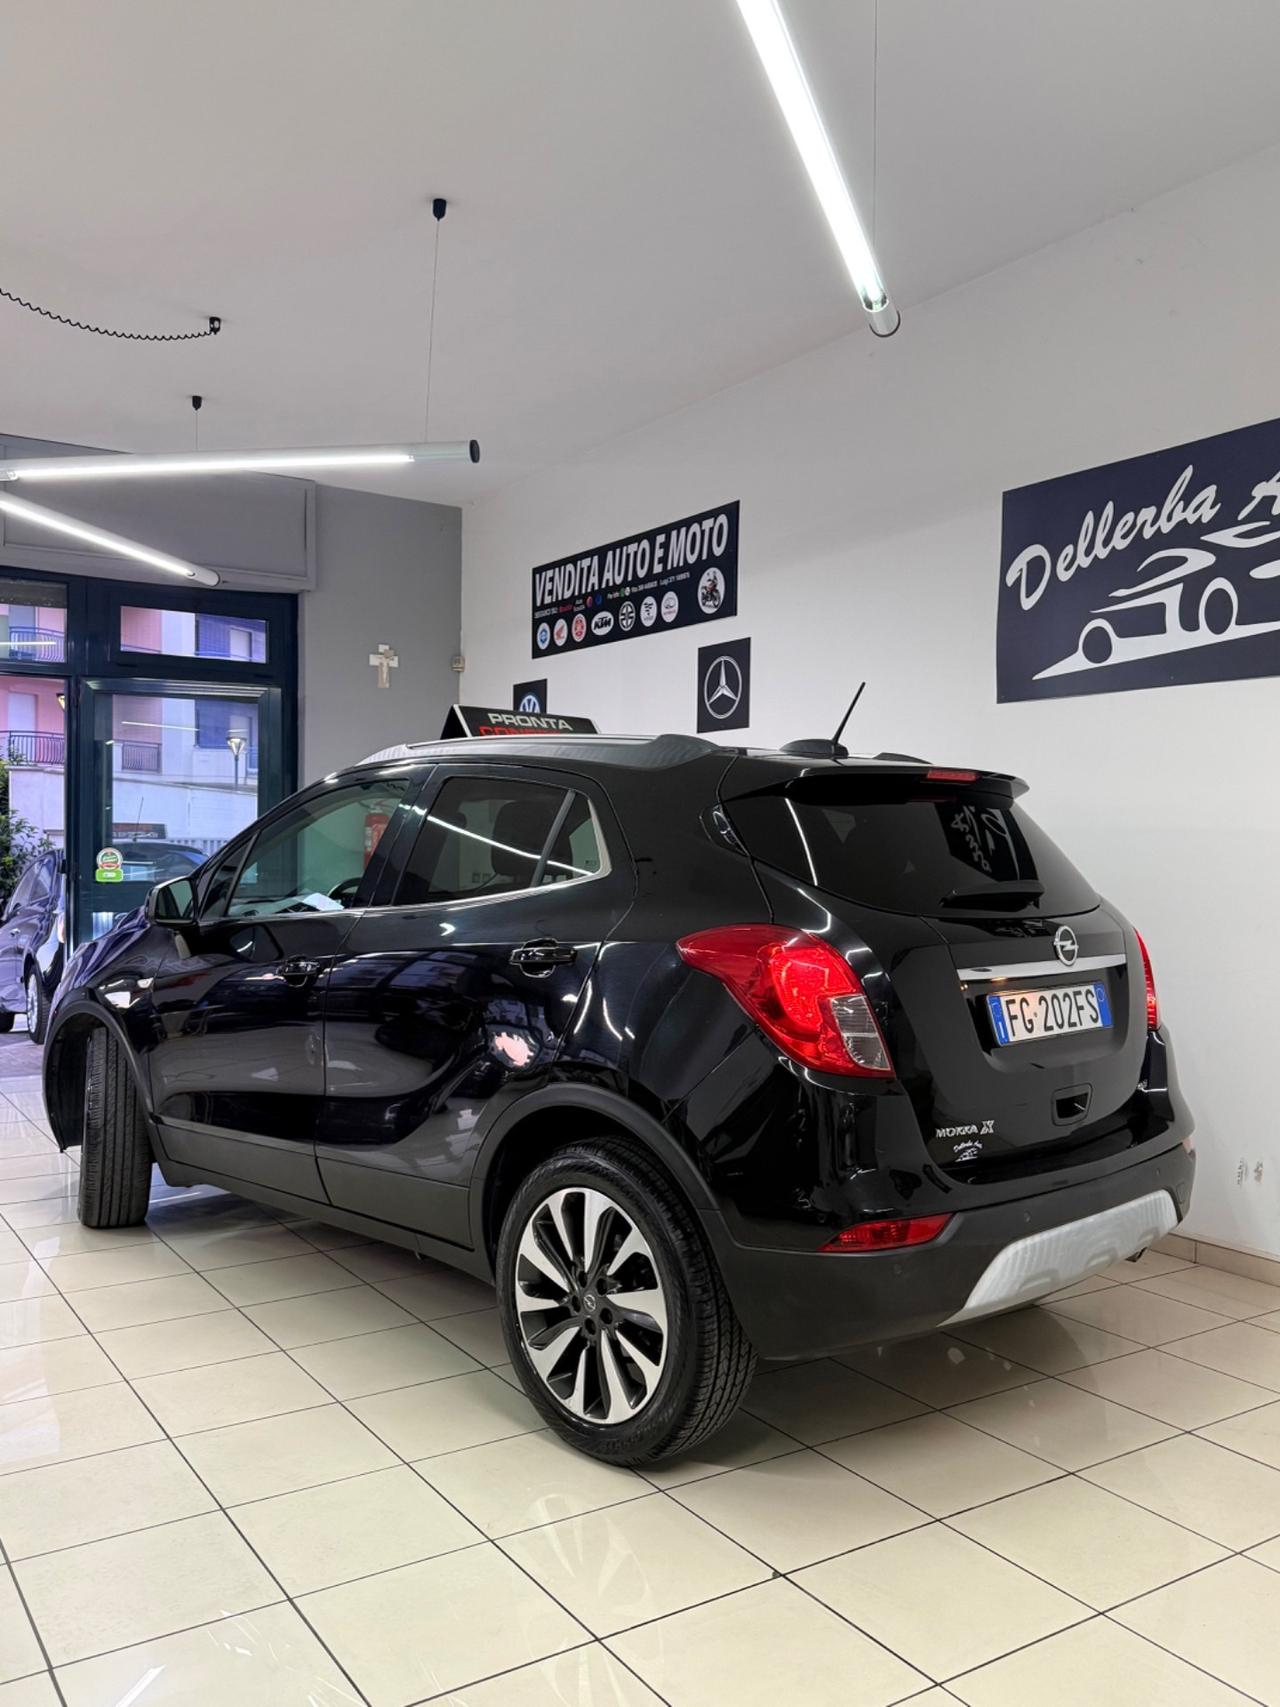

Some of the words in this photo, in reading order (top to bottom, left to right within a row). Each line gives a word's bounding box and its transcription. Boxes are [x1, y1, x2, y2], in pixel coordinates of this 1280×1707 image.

[1005, 464, 1222, 611] Dellerba
[535, 555, 600, 607] VENDITA
[601, 538, 651, 589] AUTO
[652, 533, 666, 575] E
[667, 513, 729, 571] MOTO
[594, 616, 612, 631] KTM
[487, 713, 574, 731] PRONTA
[935, 1124, 979, 1138] MOKKA
[980, 1119, 995, 1135] X
